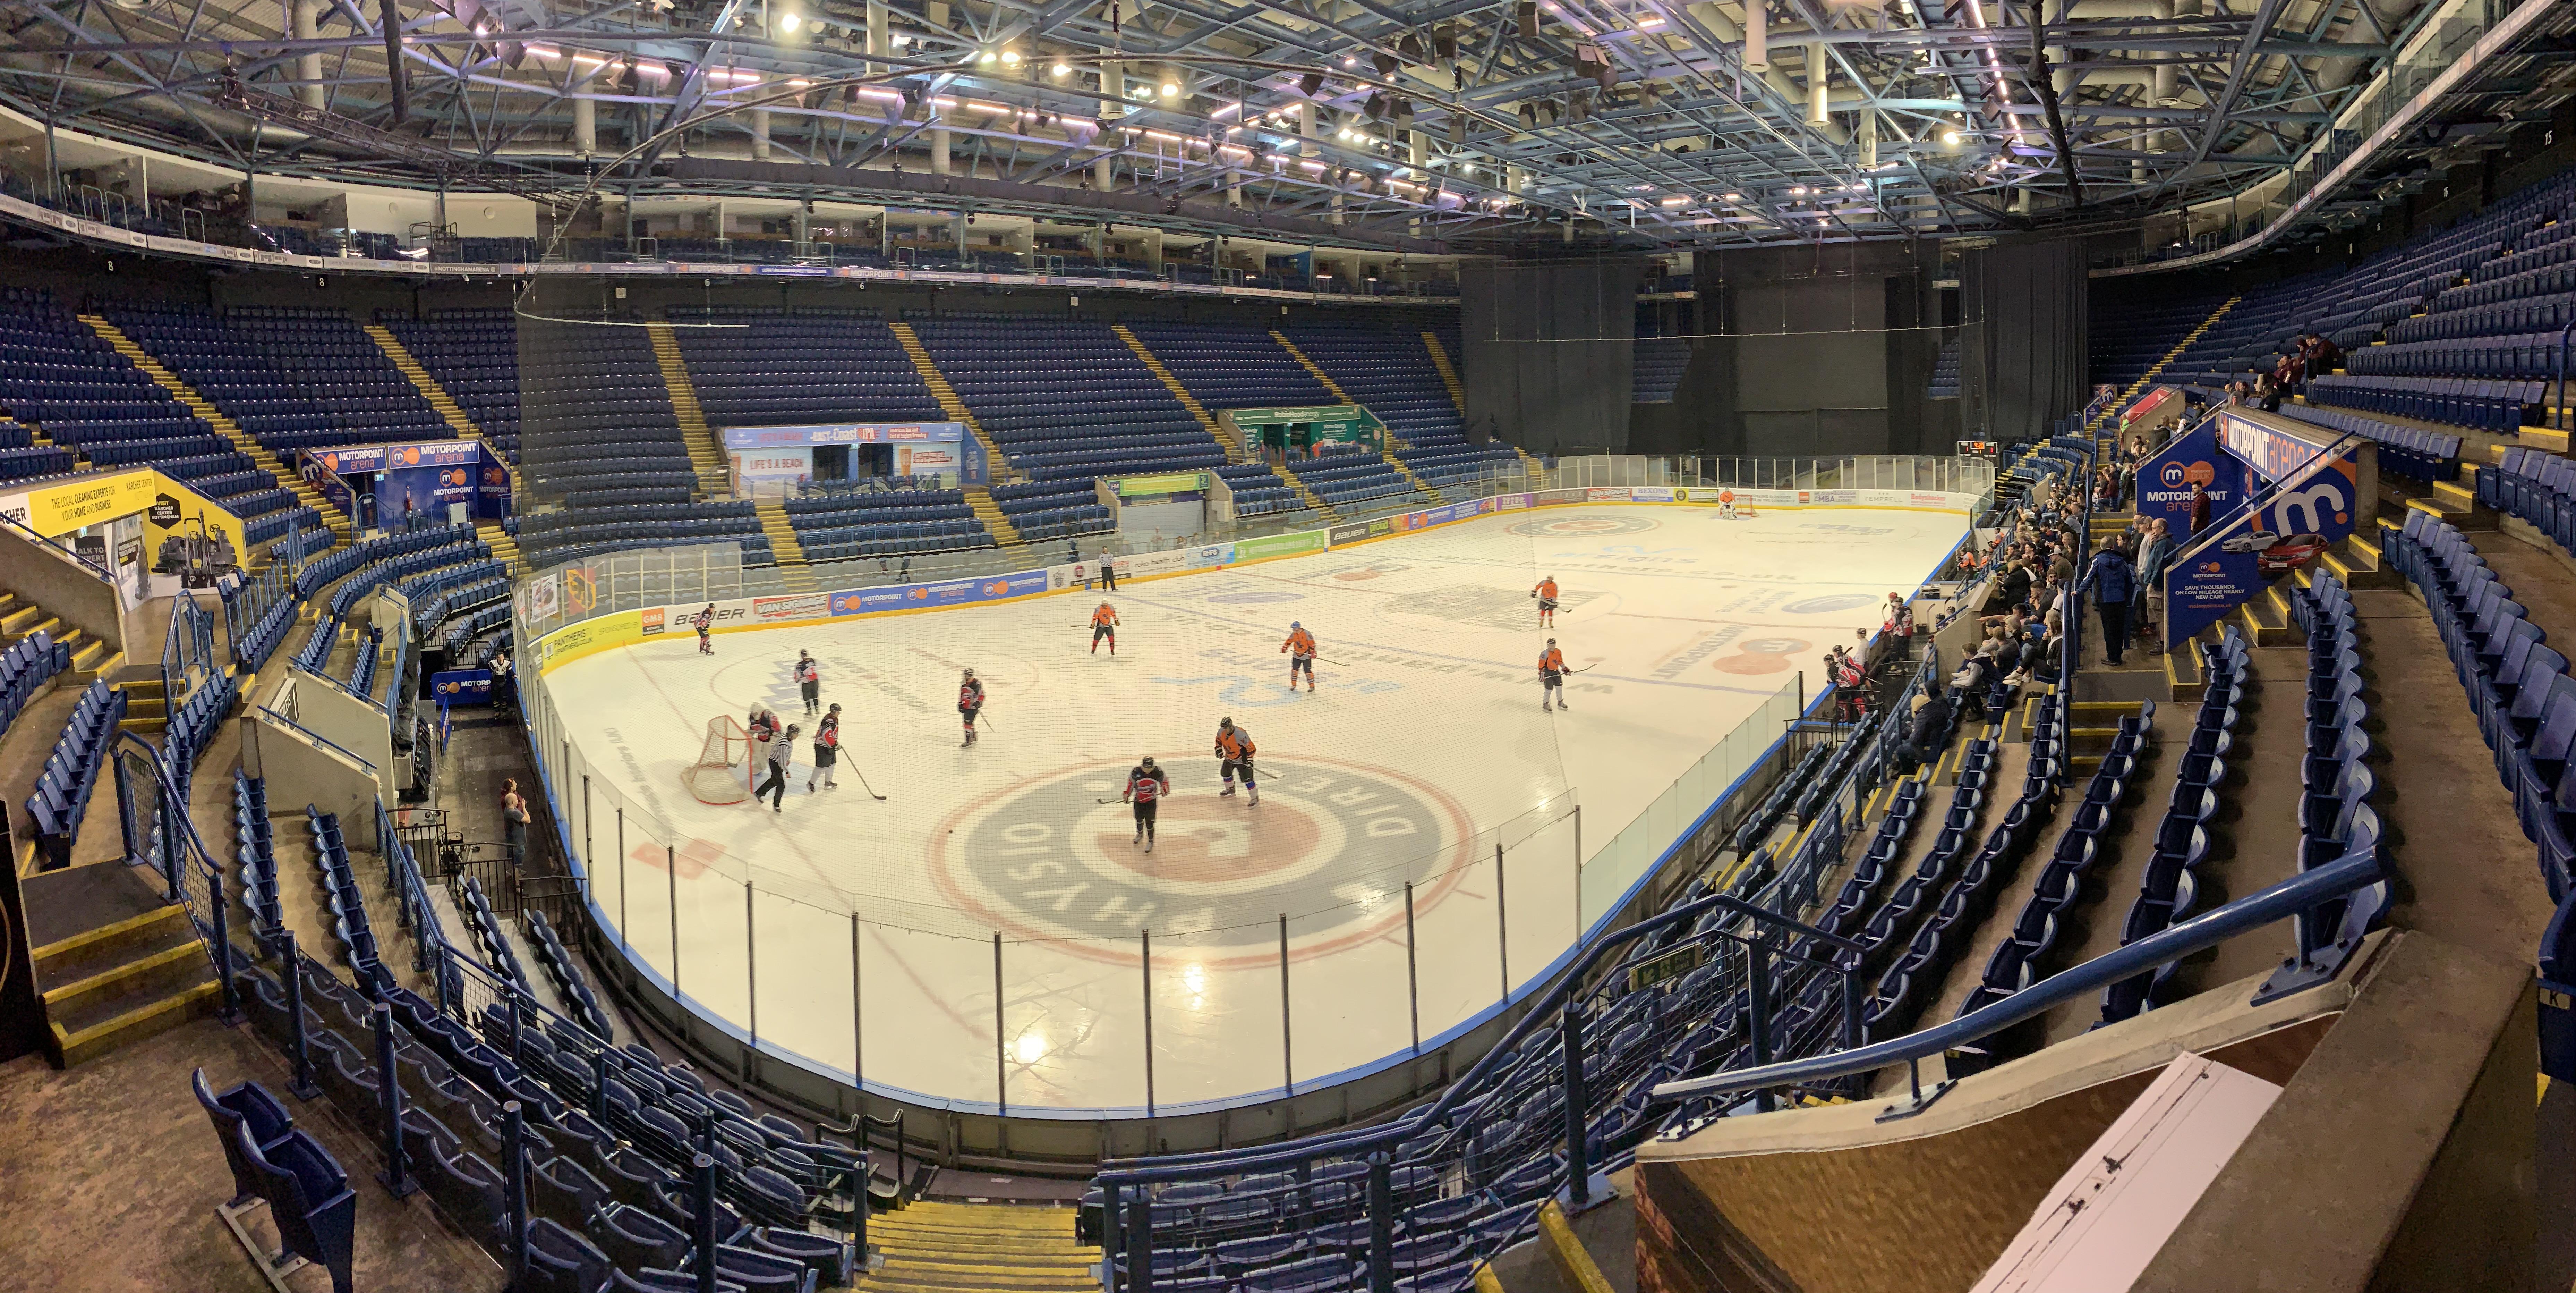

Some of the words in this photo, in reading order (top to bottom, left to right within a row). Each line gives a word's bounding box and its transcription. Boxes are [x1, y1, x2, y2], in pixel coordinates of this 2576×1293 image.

[108, 261, 114, 271] 8
[319, 278, 324, 286] 8
[863, 428, 875, 440] IPA
[421, 443, 476, 455] MOTORPOINT
[2228, 417, 2269, 471] MOTORPOINT
[339, 449, 384, 461] MOTORPOINT
[435, 453, 464, 463] arena
[350, 459, 375, 470] arena
[141, 478, 153, 488] CENTER
[434, 486, 474, 496] MOTORPOINT
[2147, 491, 2227, 501] MOTORPINT
[51, 498, 61, 509] THE
[61, 496, 74, 508] LOCAL
[74, 490, 93, 504] CLEANING
[93, 487, 109, 499] EXPERTS
[61, 509, 74, 521] YOUR
[74, 506, 86, 518] HOME
[86, 503, 95, 515] AND
[95, 499, 111, 512] BUSINESS
[862, 593, 902, 602] MOTORPOINT
[758, 602, 781, 615] VAN
[781, 594, 828, 610] SIGNAGE
[643, 613, 663, 624] GMB
